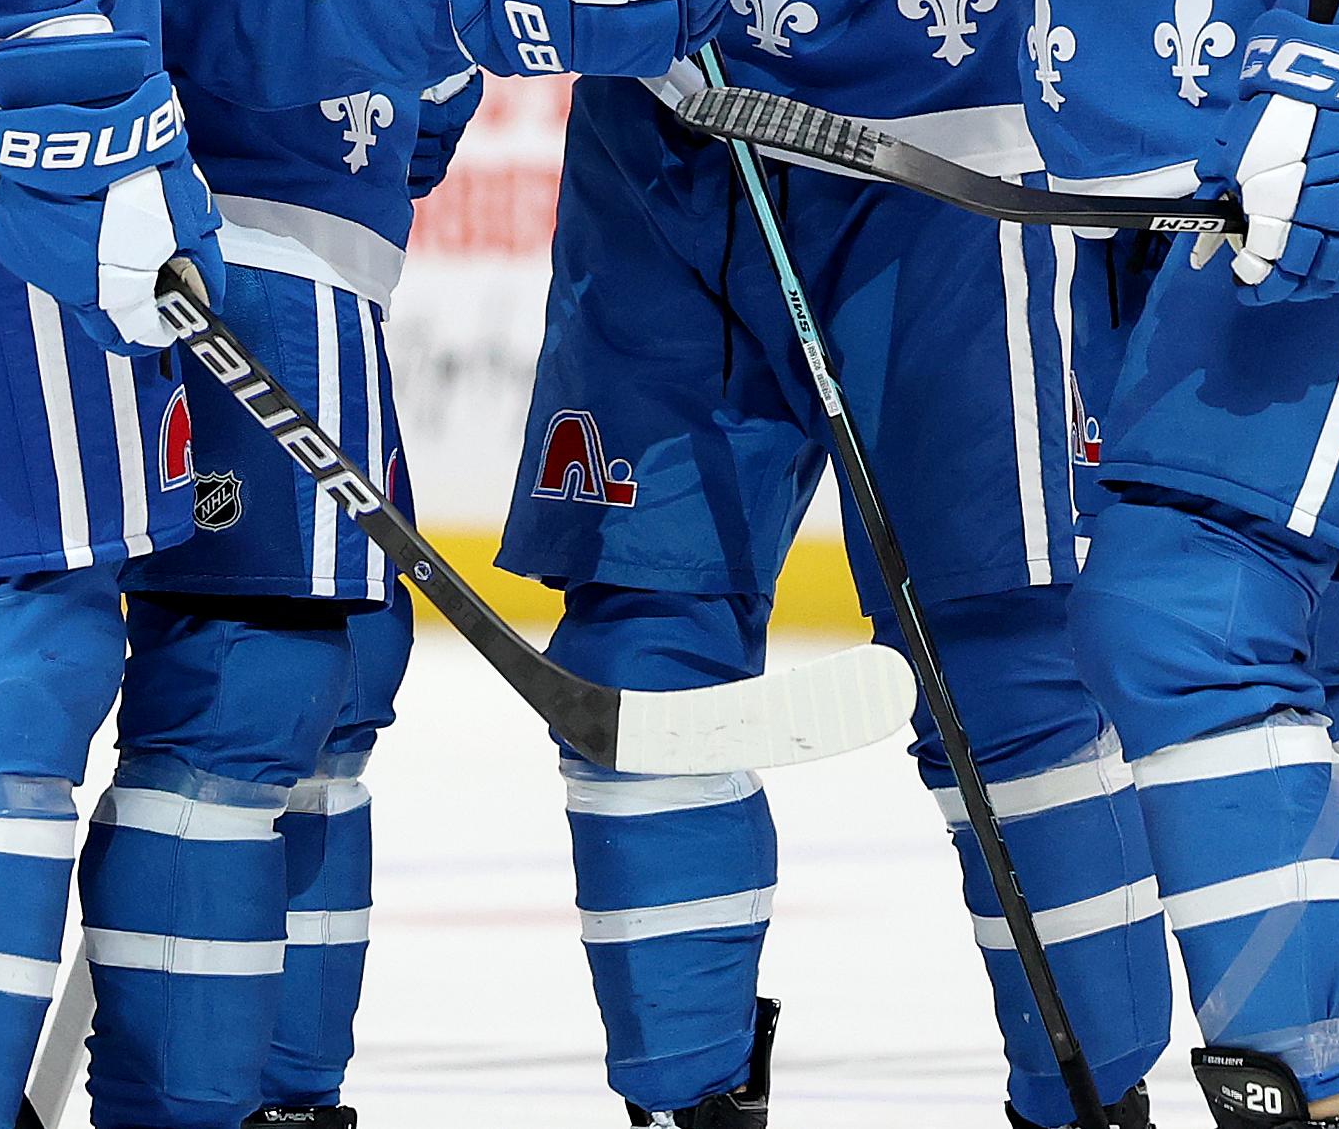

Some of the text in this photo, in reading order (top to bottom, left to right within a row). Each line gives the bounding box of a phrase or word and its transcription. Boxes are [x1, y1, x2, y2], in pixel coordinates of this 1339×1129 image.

[1155, 218, 1221, 231] CCM
[156, 291, 382, 521] BAUER
[200, 484, 234, 519] NHL
[1246, 1082, 1283, 1115] 20
